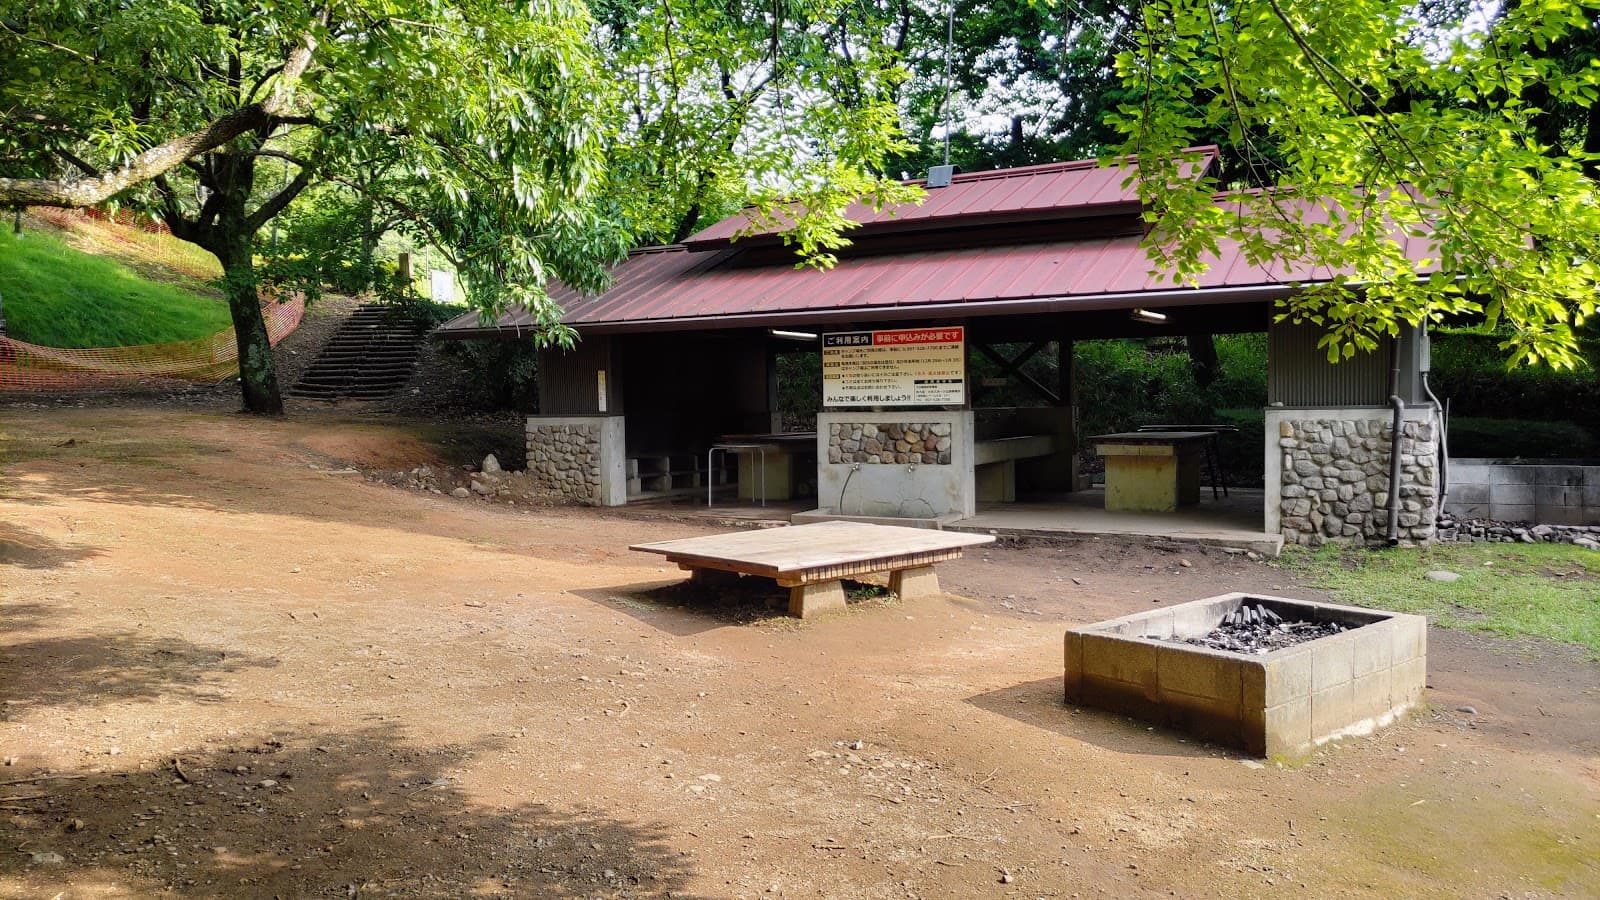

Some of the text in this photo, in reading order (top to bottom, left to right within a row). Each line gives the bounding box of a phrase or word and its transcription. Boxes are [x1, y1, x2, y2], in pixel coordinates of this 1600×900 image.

[827, 335, 869, 345] ご利用案内
